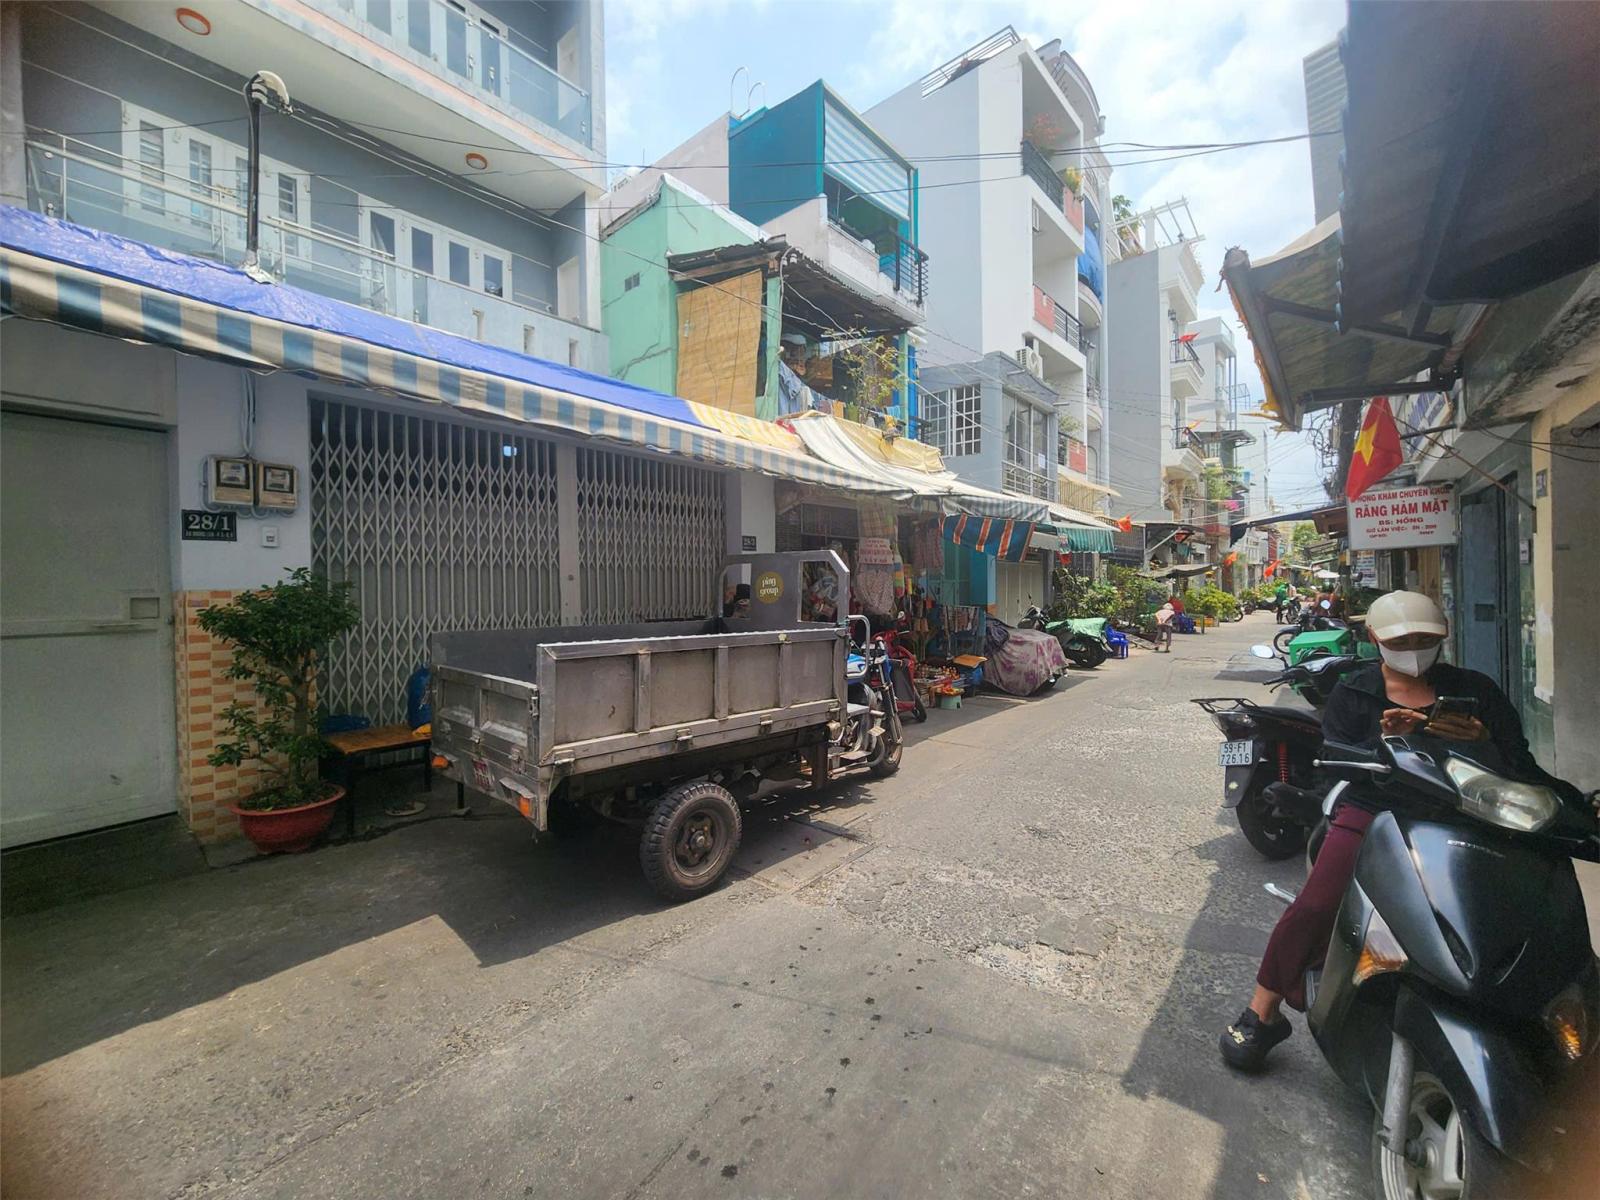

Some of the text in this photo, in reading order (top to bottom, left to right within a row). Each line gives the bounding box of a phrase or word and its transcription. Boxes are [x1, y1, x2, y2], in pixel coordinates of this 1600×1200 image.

[1355, 504, 1388, 518] RĂNG
[1421, 498, 1449, 514] MẶT
[188, 513, 231, 531] 28/1
[759, 587, 779, 597] group
